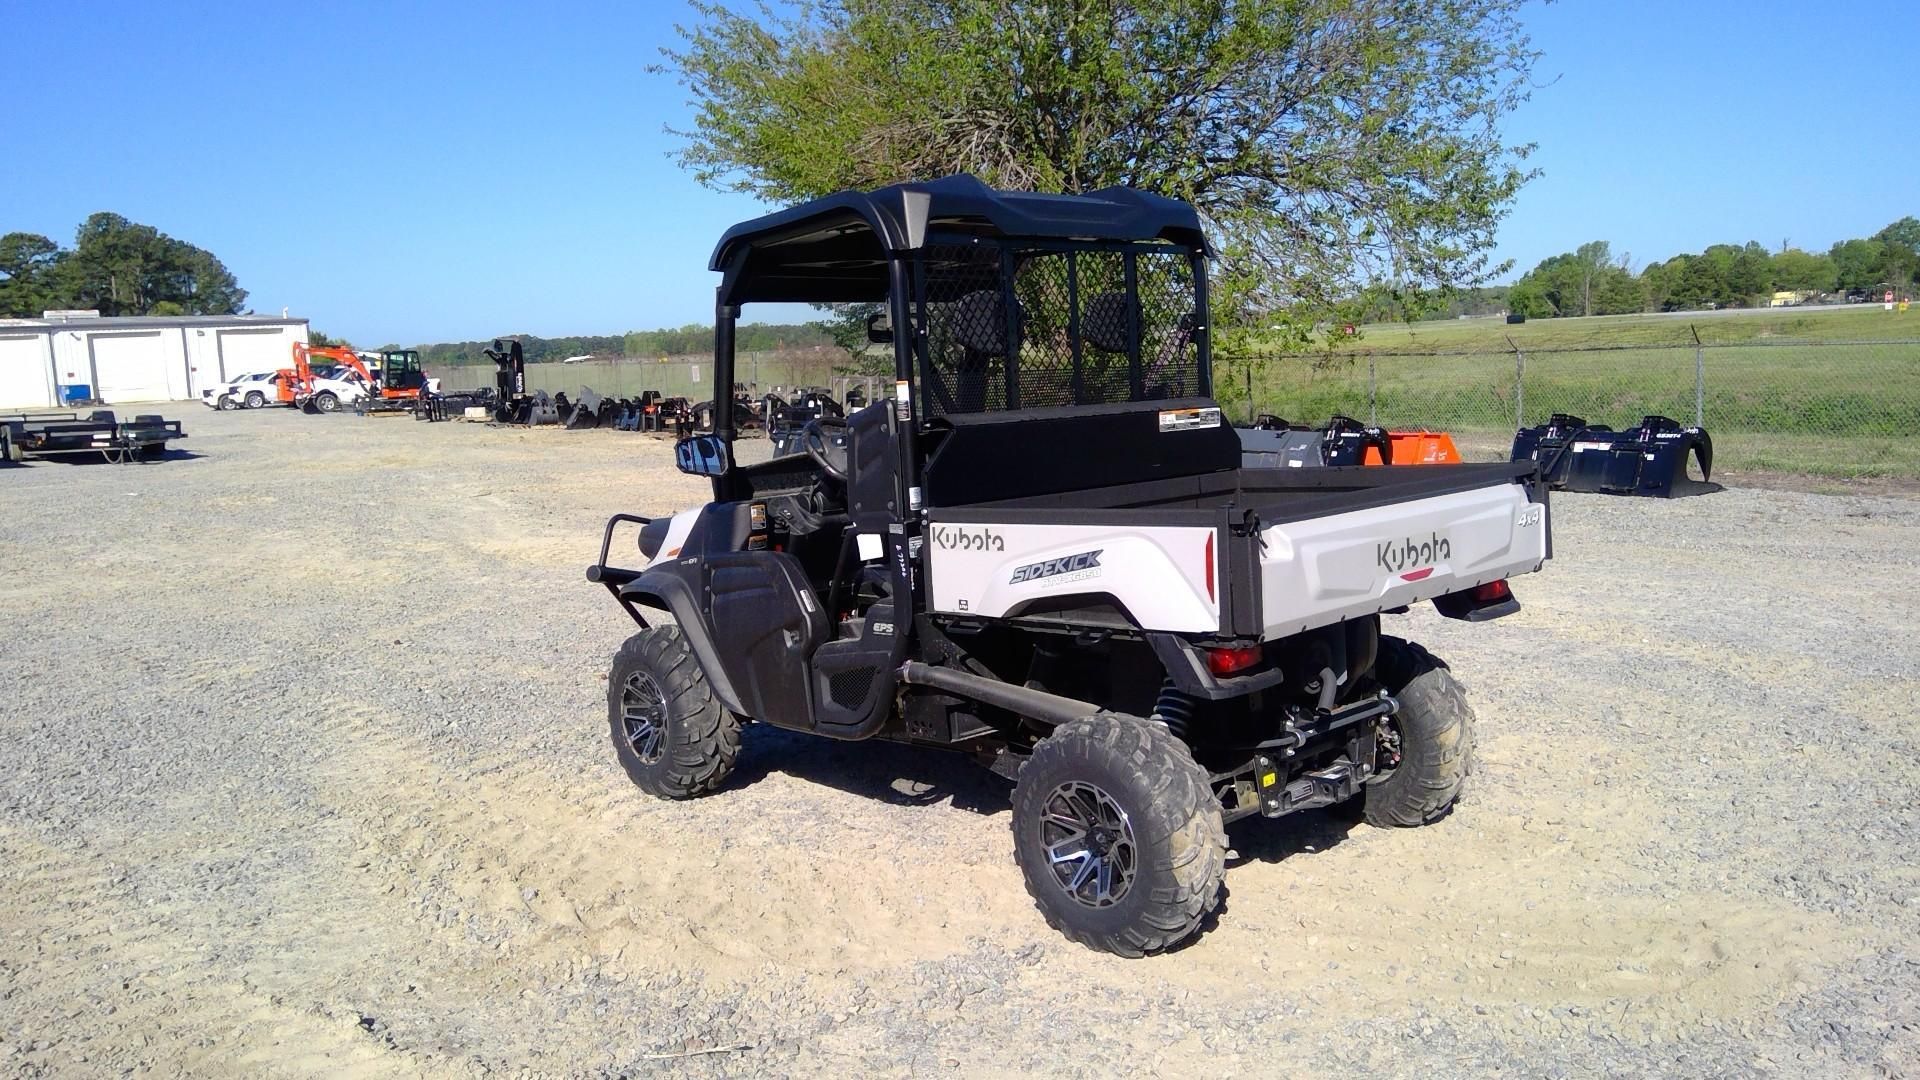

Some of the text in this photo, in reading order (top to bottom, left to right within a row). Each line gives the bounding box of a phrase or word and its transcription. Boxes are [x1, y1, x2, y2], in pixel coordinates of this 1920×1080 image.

[1518, 511, 1540, 527] 4x4
[932, 526, 1004, 552] Kubota
[1377, 531, 1451, 573] Kubota
[1009, 548, 1104, 585] SIDEKICK
[872, 622, 894, 633] EPS
